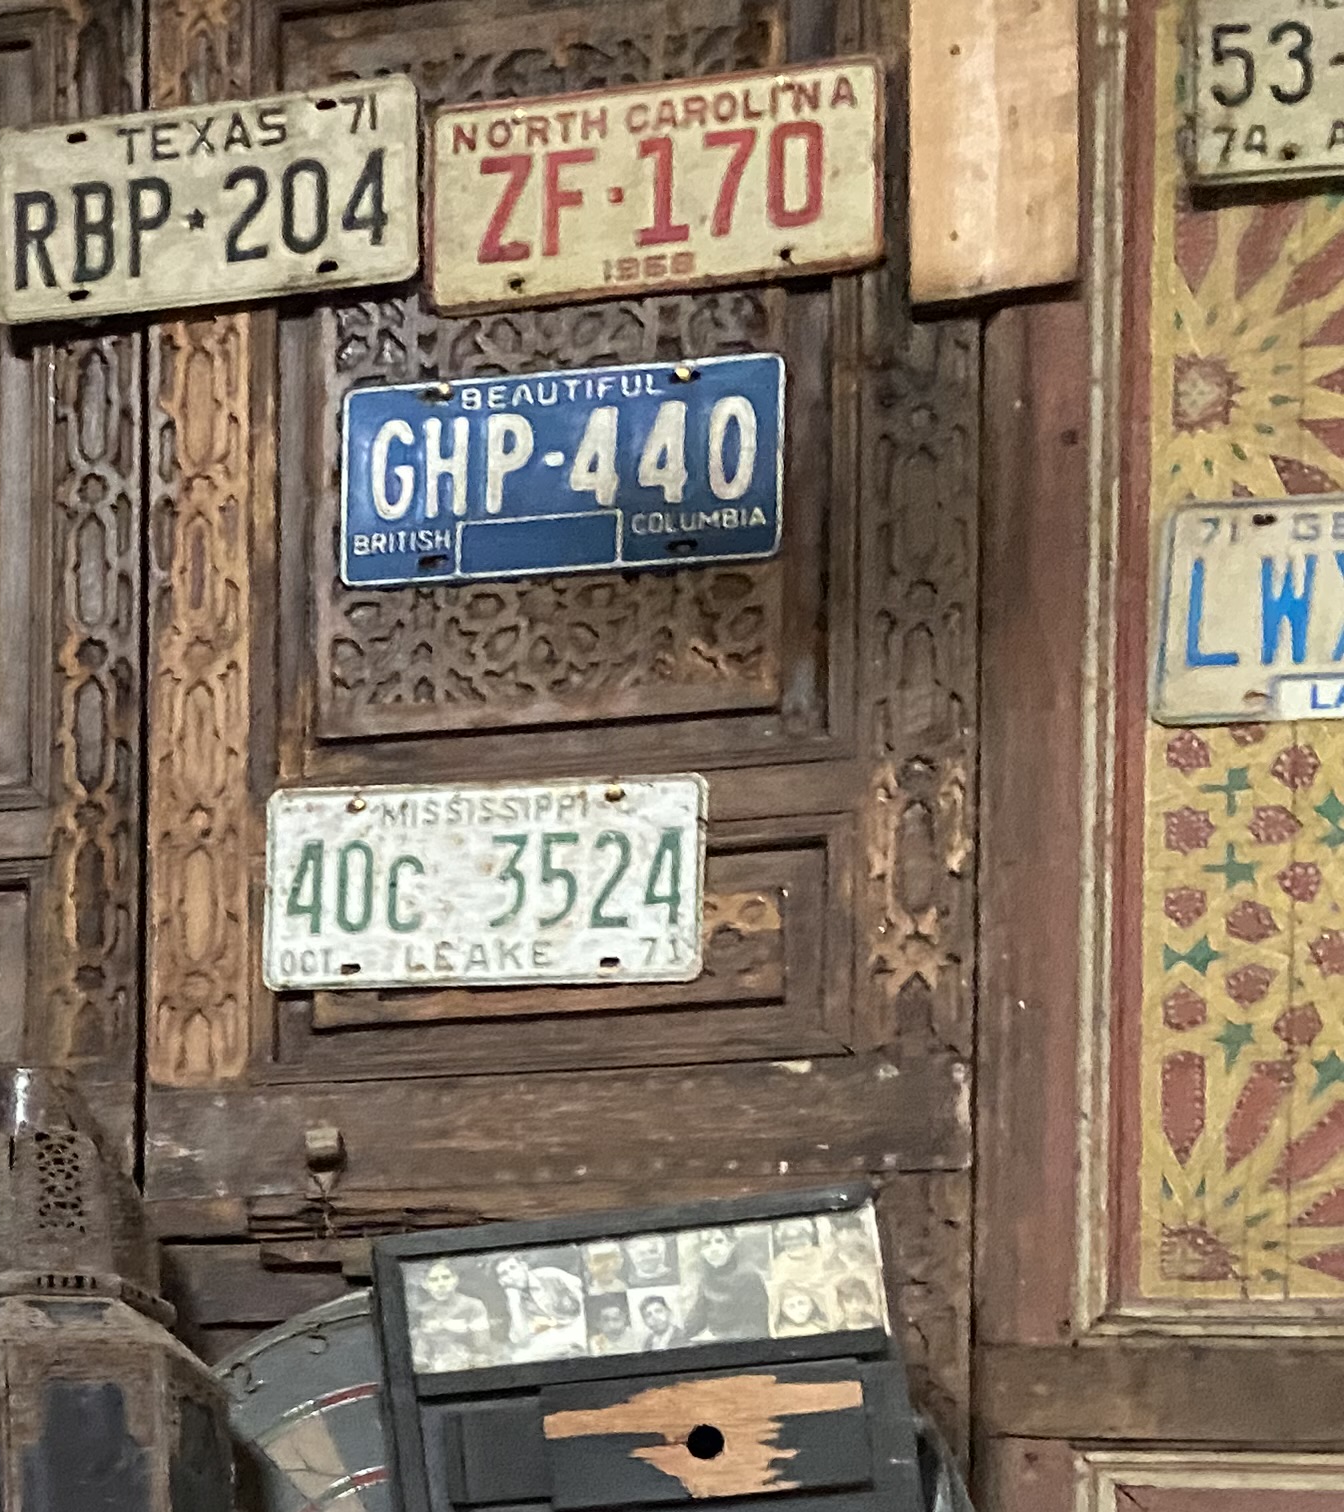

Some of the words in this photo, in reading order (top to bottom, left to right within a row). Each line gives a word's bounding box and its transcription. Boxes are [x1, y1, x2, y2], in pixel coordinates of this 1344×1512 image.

[116, 108, 287, 165] TEXAS
[342, 95, 377, 134] 71
[452, 107, 607, 155] NORTH
[625, 77, 857, 133] CAROLINA
[461, 373, 667, 410] BEAUTIFUL
[353, 529, 451, 556] BRITISH
[631, 507, 766, 535] COLUMBIA
[382, 791, 588, 826] MISSISSIPPI
[286, 839, 424, 934] 40C
[490, 826, 684, 929] 3524
[404, 939, 552, 972] LEAKE
[640, 937, 682, 966] 71
